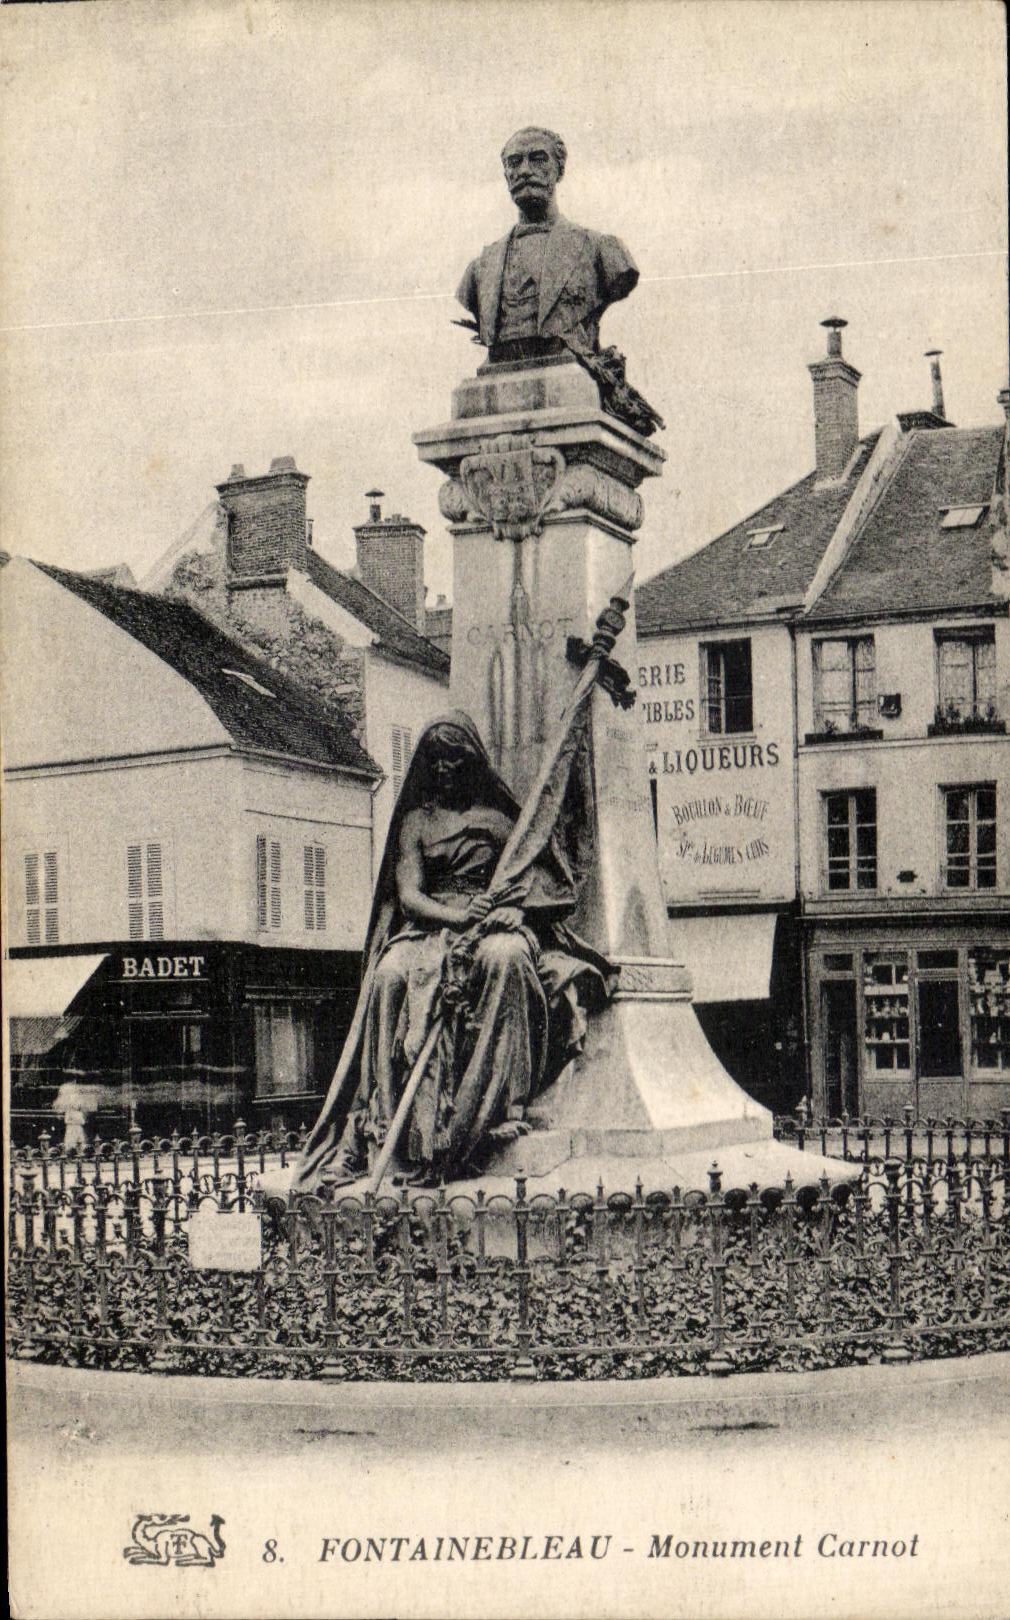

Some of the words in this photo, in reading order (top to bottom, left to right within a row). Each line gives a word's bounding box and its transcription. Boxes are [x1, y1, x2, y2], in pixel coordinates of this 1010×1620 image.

[648, 760, 658, 774] &
[662, 743, 779, 775] LIQUEURS
[122, 956, 205, 978] BADET
